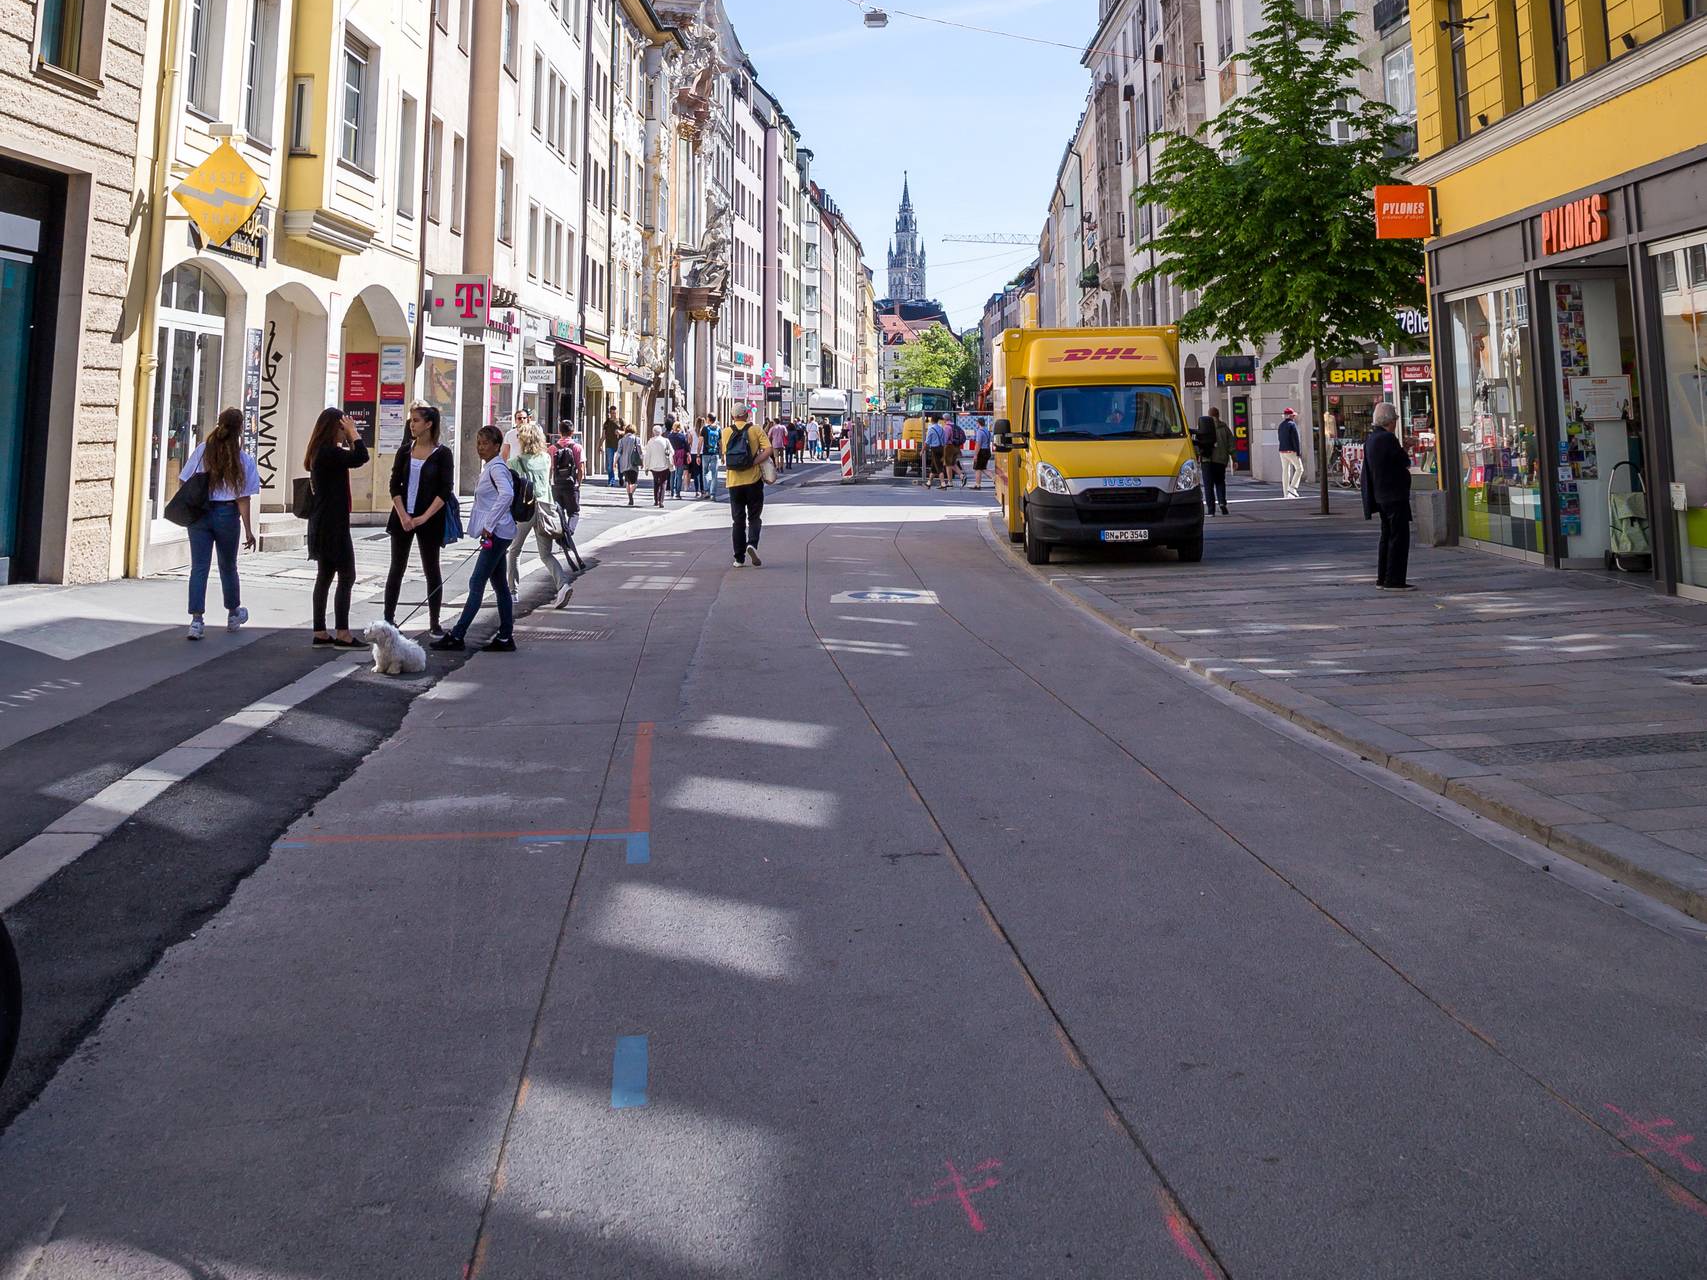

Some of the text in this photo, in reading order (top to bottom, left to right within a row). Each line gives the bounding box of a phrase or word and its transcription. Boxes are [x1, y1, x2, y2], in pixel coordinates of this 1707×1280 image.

[199, 170, 247, 184] TASTE
[1382, 201, 1425, 215] PYLONES
[1541, 193, 1603, 256] PYLONES
[455, 283, 484, 319] T
[1063, 348, 1143, 361] DHL
[1329, 368, 1382, 383] BART
[1103, 478, 1142, 487] IVECO
